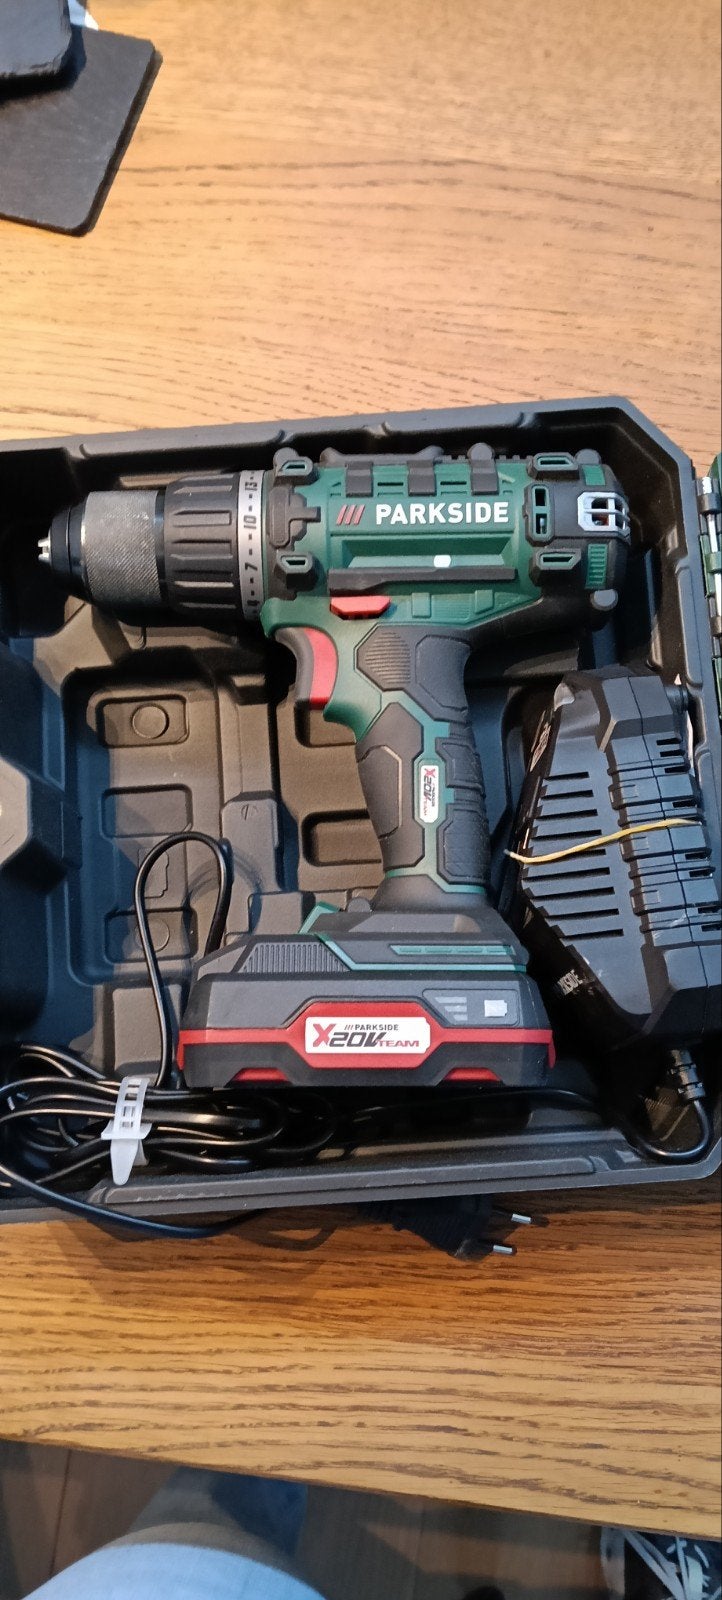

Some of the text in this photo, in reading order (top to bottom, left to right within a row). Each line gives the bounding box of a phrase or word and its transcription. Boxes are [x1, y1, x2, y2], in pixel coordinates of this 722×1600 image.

[244, 482, 257, 491] 13
[375, 501, 509, 525] PARKSIDE
[244, 516, 257, 529] 10
[244, 562, 258, 571] 7
